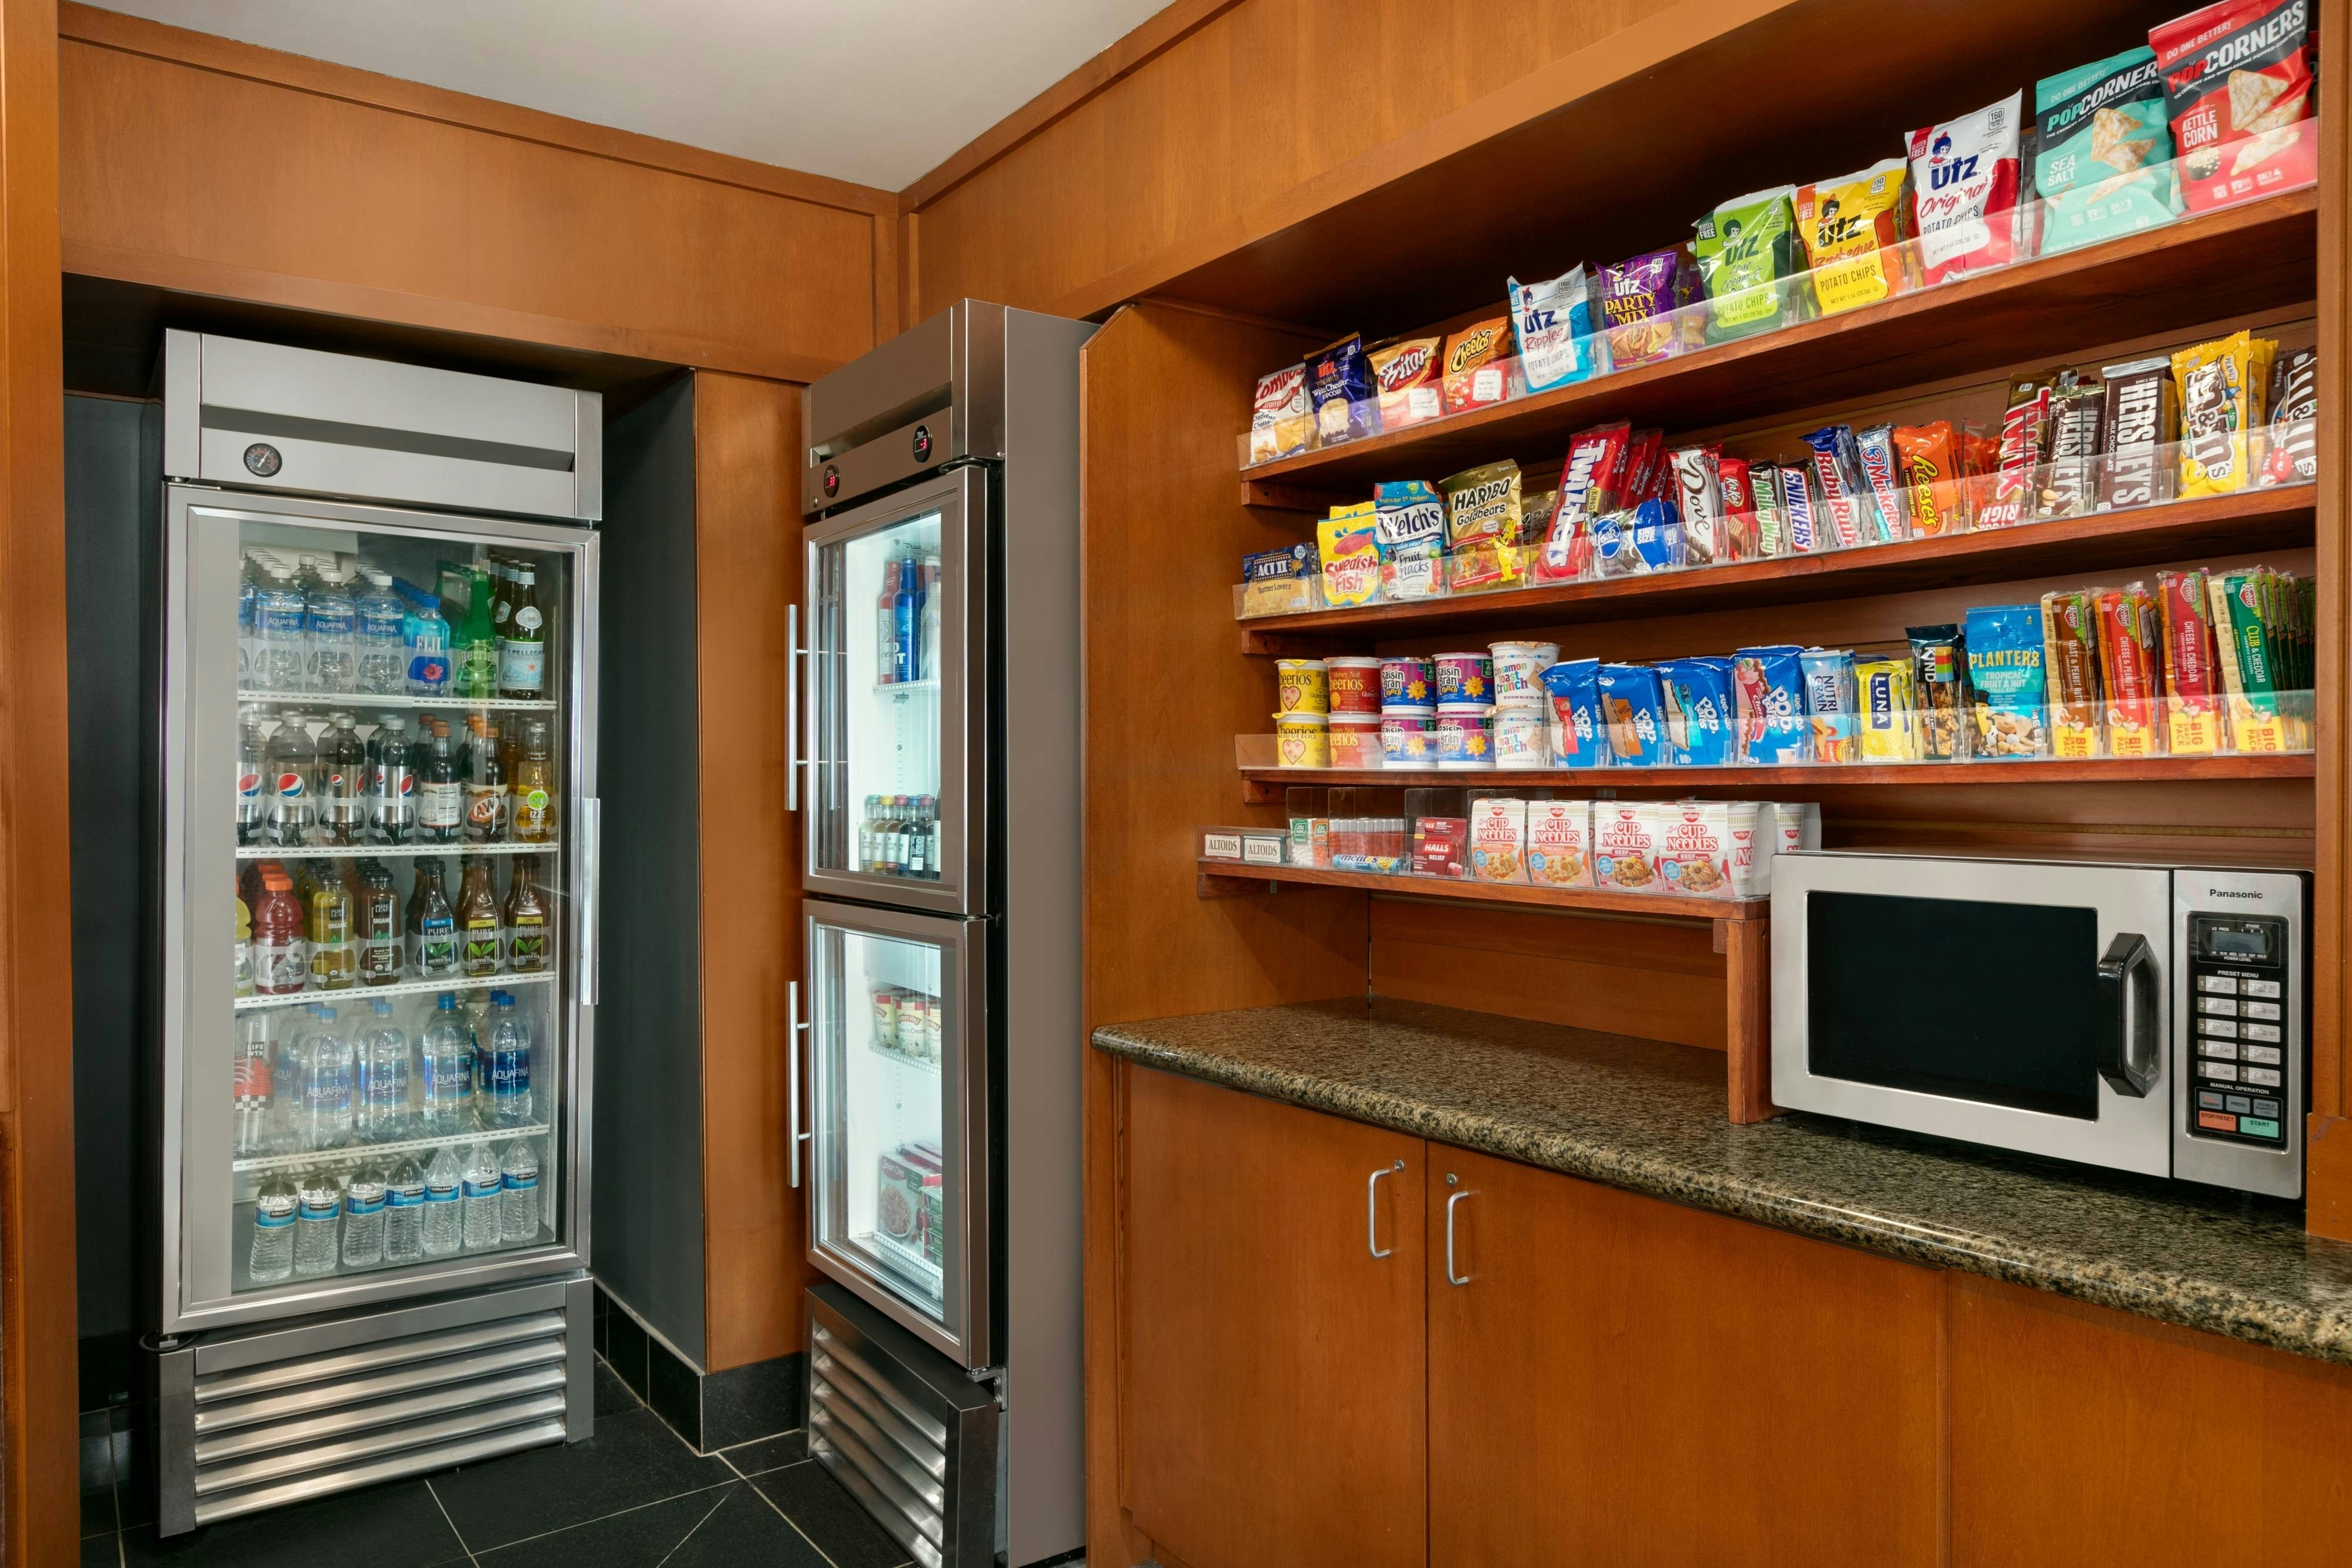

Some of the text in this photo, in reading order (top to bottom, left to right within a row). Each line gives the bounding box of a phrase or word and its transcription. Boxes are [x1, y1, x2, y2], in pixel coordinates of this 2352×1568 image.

[2167, 21, 2231, 60] DO ONE BETTER!
[2167, 1, 2304, 93] POPCORNERS
[2063, 85, 2076, 97] ONE
[1990, 110, 2003, 121] 160
[2182, 110, 2217, 132] KETTLE
[2183, 123, 2218, 148] CORN
[1912, 140, 1926, 151] GLUTEN
[1911, 149, 1926, 161] FREE
[2050, 155, 2076, 175] SEA
[2048, 167, 2075, 186] SALT
[1799, 209, 1813, 220] FREE
[1923, 205, 1978, 235] POTATO CHIPS
[1699, 222, 1713, 232] GLUTEN
[1699, 229, 1715, 239] FREE
[1820, 265, 1876, 292] POTATO CHIPS
[1604, 293, 1656, 315] PARTY
[1746, 293, 1769, 309] CHIPS
[1615, 310, 1650, 326] MIX
[1525, 327, 1563, 352] Ripples
[1451, 330, 1491, 373] Cheetos
[1379, 348, 1427, 392] Fritos
[2224, 357, 2237, 383] PEANUT
[2112, 381, 2159, 505] HERSHEY'S
[1815, 450, 1841, 500] Baby
[1454, 477, 1512, 512] HARIBO
[1679, 456, 1710, 537] Dove
[1912, 455, 1939, 528] Reese's
[1456, 504, 1506, 526] Goldbears
[1785, 471, 1811, 547] SNICKERS
[1979, 504, 2020, 523] RIGH
[1378, 507, 1440, 537] Welch's
[1637, 534, 1655, 545] SIZE
[1638, 526, 1655, 537] KING
[1399, 550, 1422, 564] Fruit
[1258, 562, 1275, 577] ACT
[1277, 560, 1288, 573] II
[1325, 554, 1378, 585] Swedish
[1258, 583, 1292, 594] Butter Lovers
[1335, 571, 1364, 595] Fish
[2184, 578, 2195, 601] Keebler
[2242, 583, 2256, 607] Keebler
[268, 617, 299, 626] AQUAFINA
[316, 620, 347, 630] AQUAFINA
[367, 623, 397, 633] AQUAFINA
[2184, 621, 2194, 644] CHEESE
[416, 636, 441, 653] FIJI
[2120, 636, 2129, 658] CHEESE
[1970, 650, 2040, 668] PLANTERS
[2246, 626, 2260, 647] CLUB
[2253, 653, 2266, 683] CHEDDAR
[1437, 668, 1460, 677] Raisin
[1924, 647, 1936, 683] KIND
[2187, 652, 2198, 683] CHEDDAR
[1382, 671, 1404, 681] Raisin
[1440, 677, 1458, 686] Bran
[1985, 671, 2022, 680] TROPICAL
[2069, 639, 2084, 708] TOAST PEANUT BUTTER
[2125, 664, 2133, 687] PEANUT
[1384, 680, 1401, 688] Bran
[1440, 686, 1458, 695] Crunch
[1980, 679, 2027, 688] FRUIT & NUT
[1815, 676, 1828, 713] GRAIN
[1823, 676, 1838, 711] NUTRI
[1875, 677, 1888, 724] LUNA
[2127, 687, 2137, 710] BUTTER
[1753, 694, 1763, 725] Cherry
[1384, 735, 1400, 744] Bran
[1441, 735, 1459, 744] Bran
[2176, 723, 2184, 746] PACK
[2191, 722, 2203, 746] BIG
[2262, 727, 2277, 751] BIG
[530, 810, 546, 818] IZZE
[1487, 818, 1509, 830] CUP
[1546, 819, 1571, 831] CUP
[1614, 821, 1641, 834] CUP
[1678, 824, 1707, 838] CUP
[1478, 829, 1516, 841] NOODLES
[1535, 831, 1581, 844] NOODLES
[1602, 833, 1652, 848] NOODLES
[1209, 841, 1238, 852] ALTOIDS
[1248, 845, 1278, 856] ALTOIDS
[1425, 844, 1449, 852] HALLS
[1666, 837, 1719, 852] NOODLES
[2210, 889, 2263, 899] Panasonic
[432, 1070, 470, 1085] AQUAFINA
[492, 1065, 529, 1080] AQUAFINA
[307, 1084, 349, 1097] AQUAFINA
[368, 1076, 407, 1091] AQUAFINA
[2235, 1086, 2269, 1095] OPERATION
[2201, 1113, 2234, 1122] STOP/RESET
